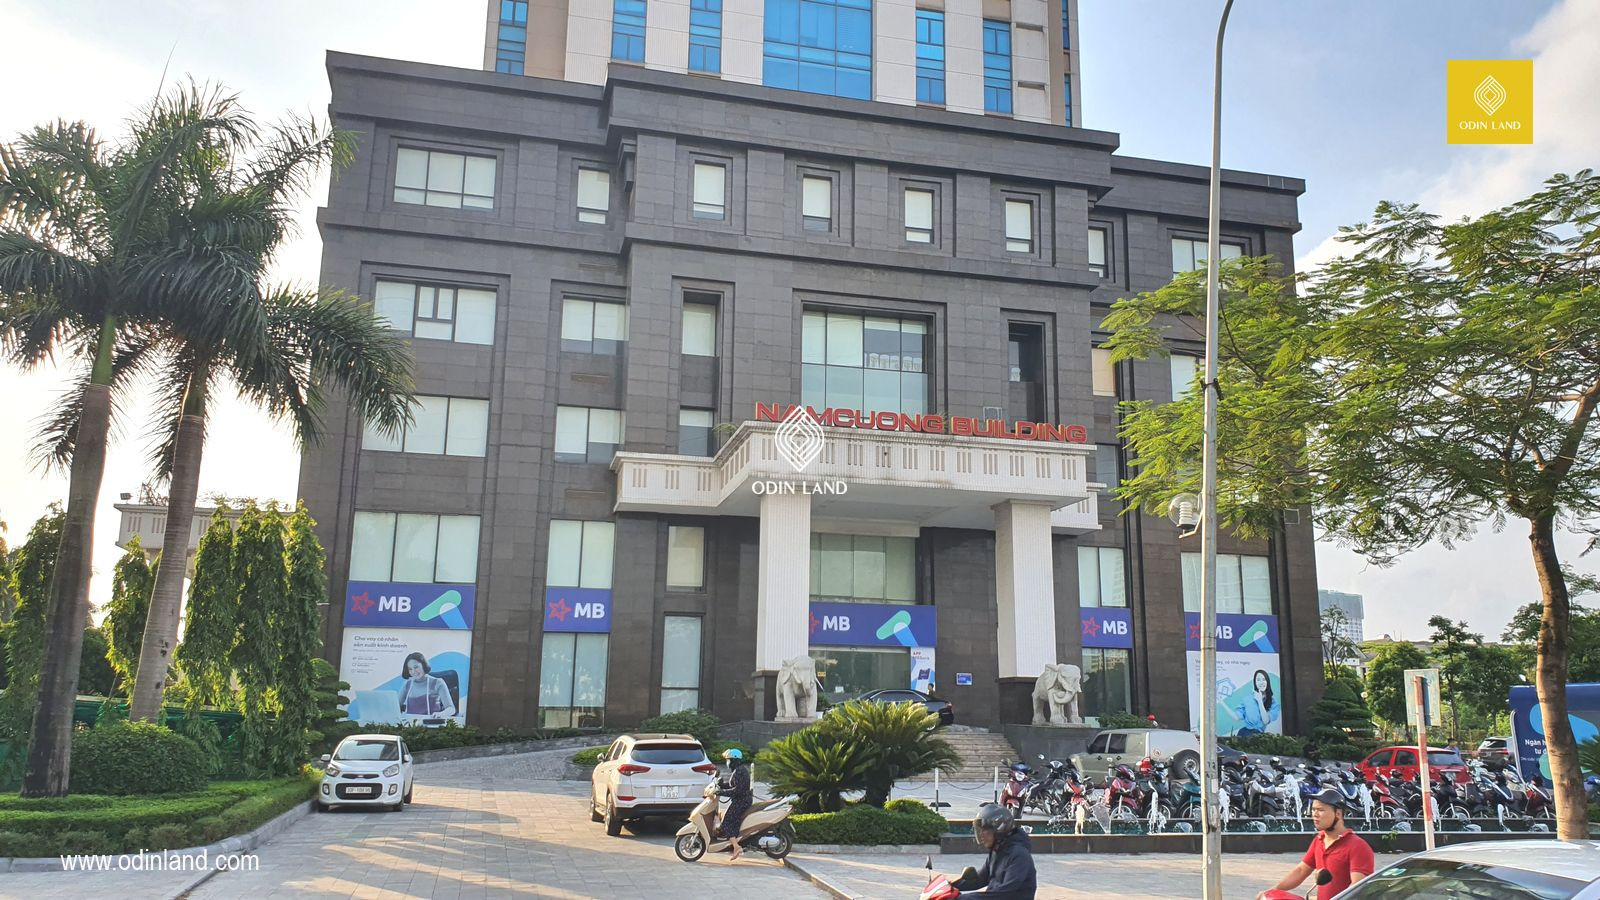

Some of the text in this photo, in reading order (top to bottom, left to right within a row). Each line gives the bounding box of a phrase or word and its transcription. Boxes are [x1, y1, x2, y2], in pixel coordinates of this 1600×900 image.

[755, 401, 1088, 443] NAMCUONG BUILDING
[378, 595, 412, 613] MB
[573, 602, 605, 619] MB
[822, 615, 851, 632] MB
[1102, 620, 1128, 635] MB
